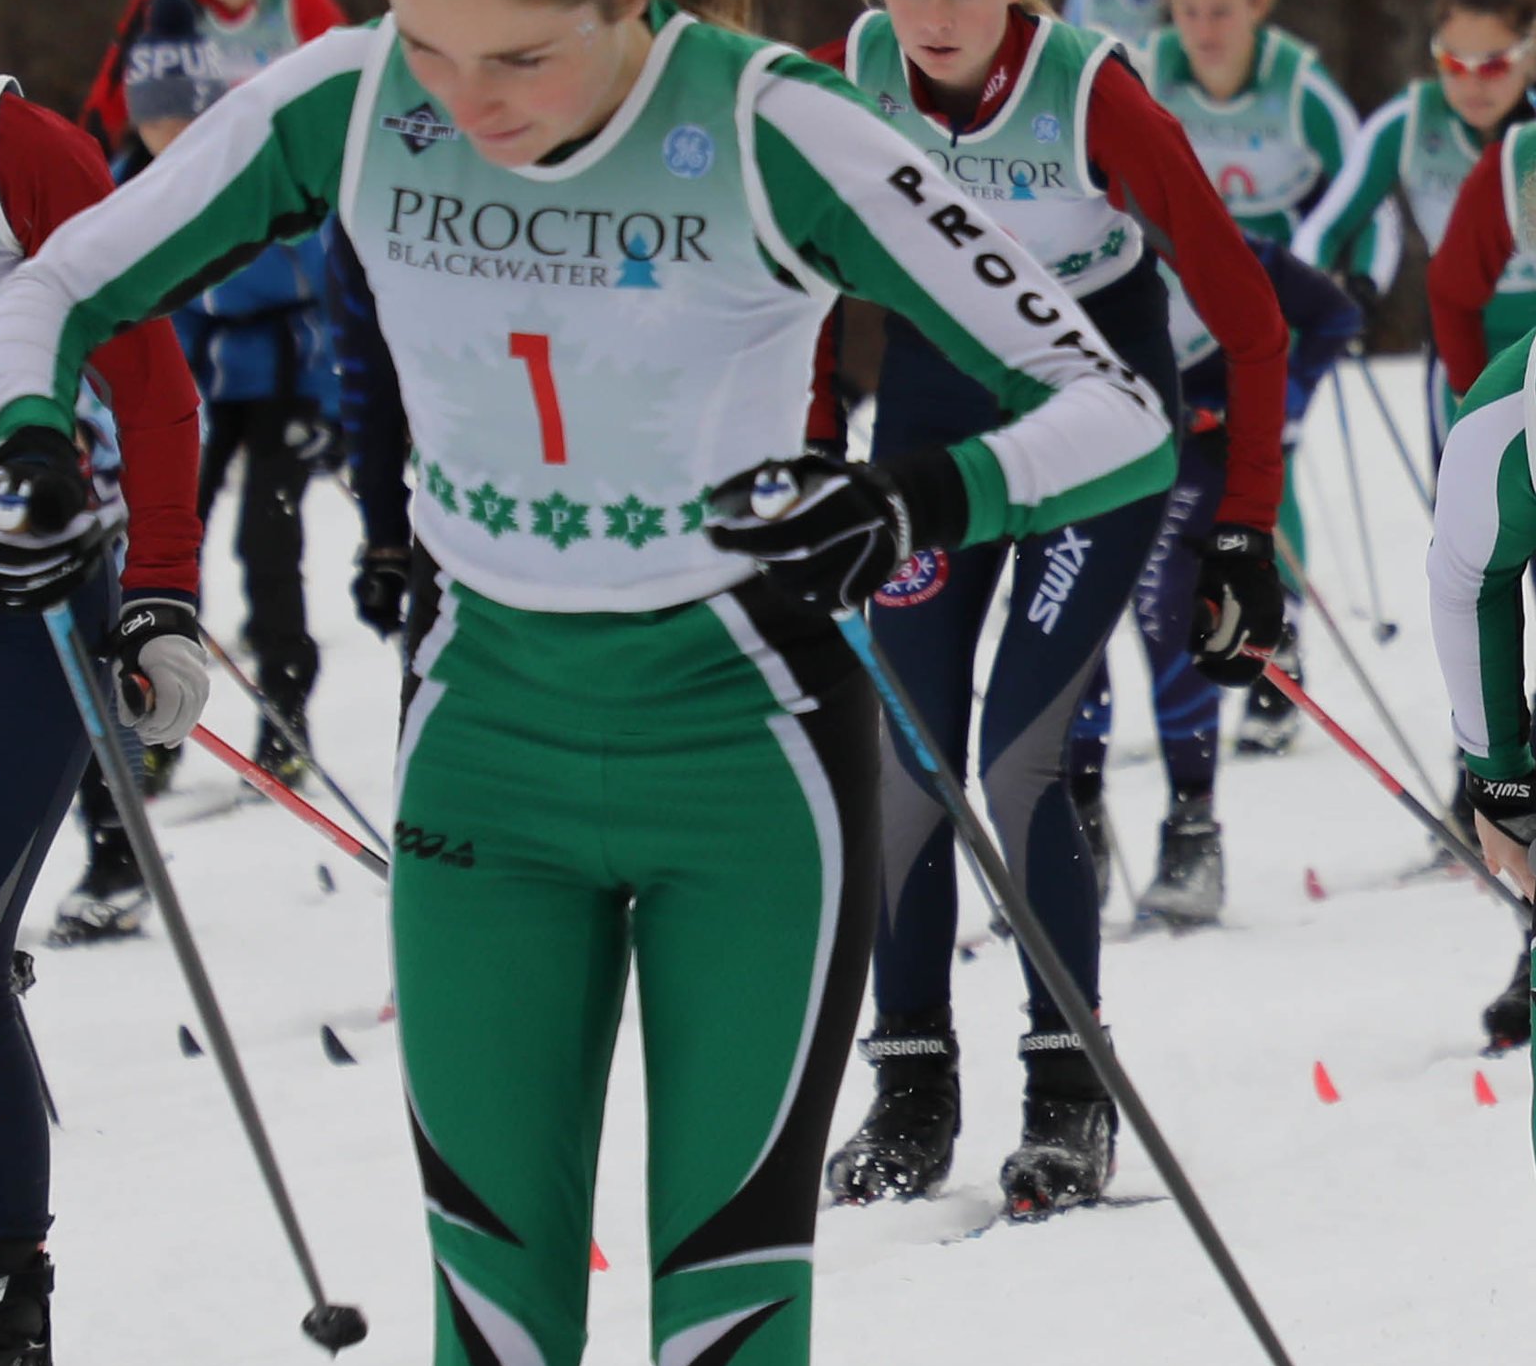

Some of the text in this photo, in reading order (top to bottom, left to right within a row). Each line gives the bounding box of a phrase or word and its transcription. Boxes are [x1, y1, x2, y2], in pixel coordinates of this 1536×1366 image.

[924, 149, 1066, 189] OCTOR
[387, 187, 712, 263] PROCTOR
[387, 239, 610, 289] BLACKWATER
[509, 332, 568, 465] 1
